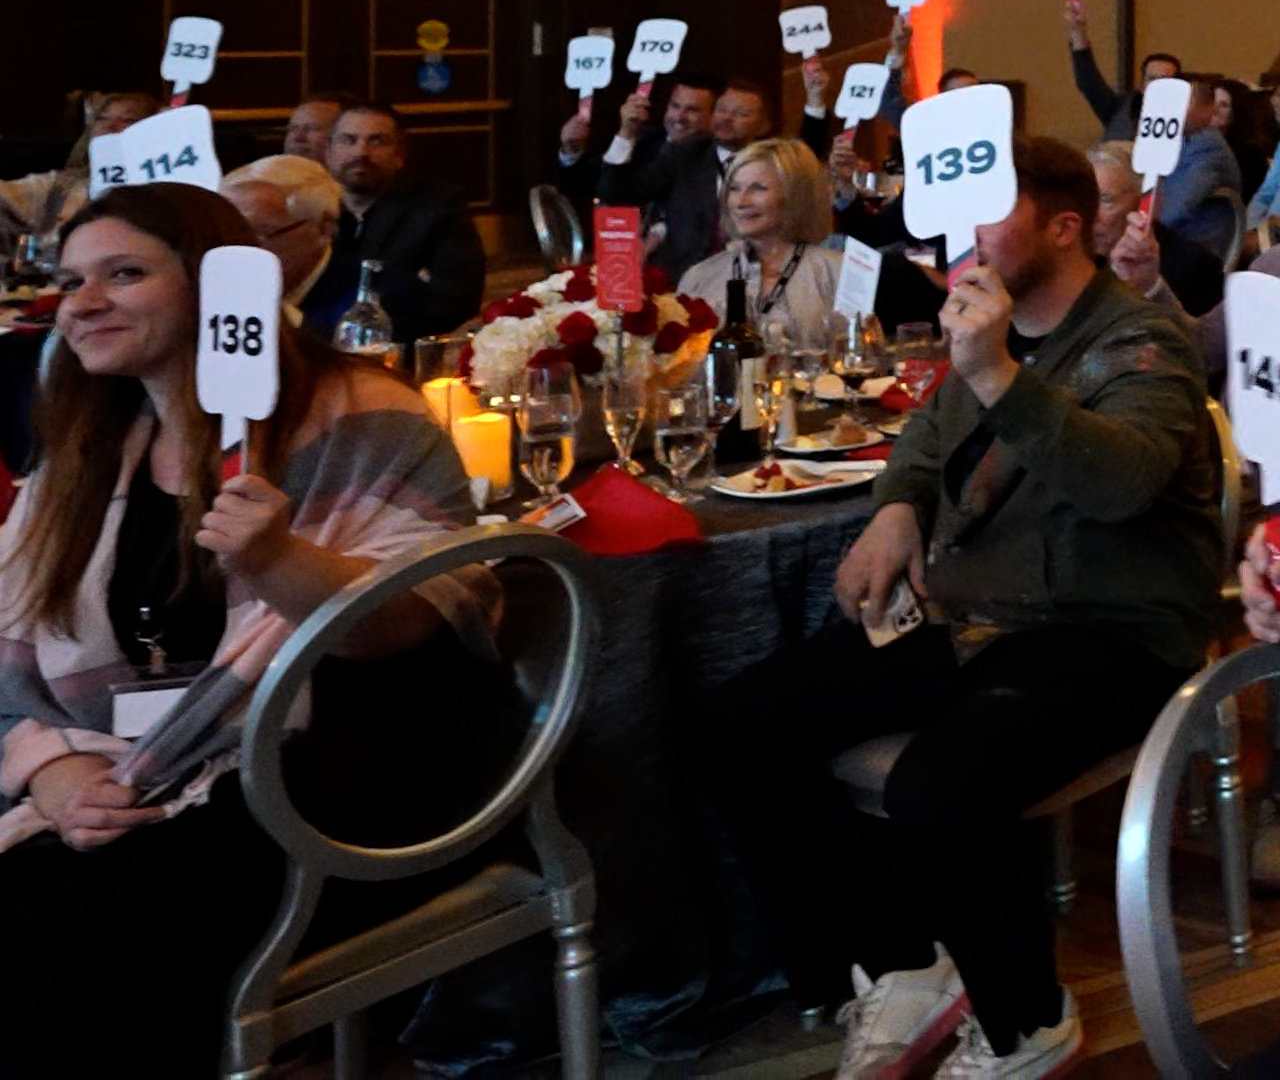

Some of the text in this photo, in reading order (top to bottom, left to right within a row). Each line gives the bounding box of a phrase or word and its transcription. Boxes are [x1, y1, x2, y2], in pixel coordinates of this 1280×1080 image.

[787, 23, 824, 37] 244
[171, 42, 210, 59] 323
[641, 41, 674, 53] 170
[574, 57, 605, 70] 167
[850, 86, 875, 98] 121
[1141, 117, 1179, 139] 300
[141, 146, 198, 179] 114
[917, 140, 996, 185] 139
[99, 166, 126, 183] 12
[209, 315, 263, 356] 138
